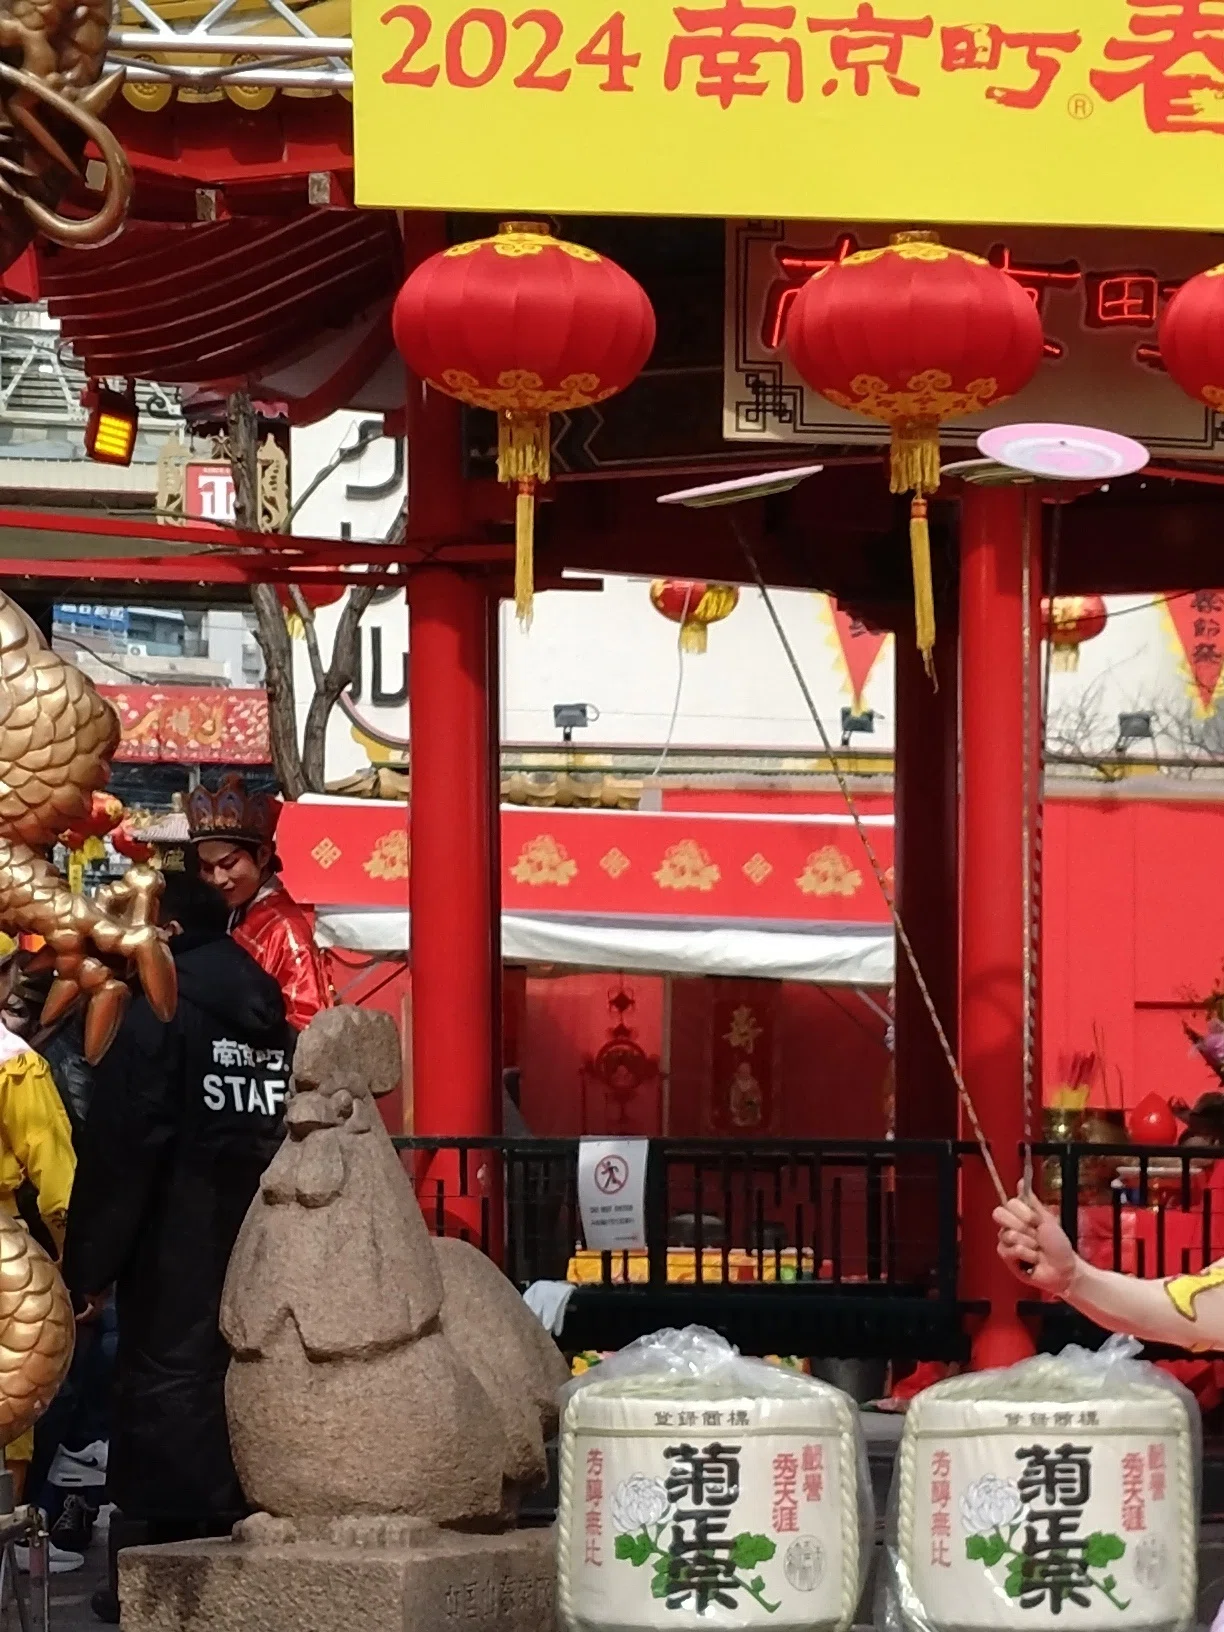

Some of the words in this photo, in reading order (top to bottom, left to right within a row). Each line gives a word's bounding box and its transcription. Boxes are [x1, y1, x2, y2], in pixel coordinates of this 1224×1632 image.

[380, 5, 641, 92] 2024
[203, 1074, 286, 1115] STAF
[212, 1038, 289, 1071] 南京町
[662, 1442, 742, 1615] 菊正宗
[1015, 1443, 1094, 1615] 菊正宗
